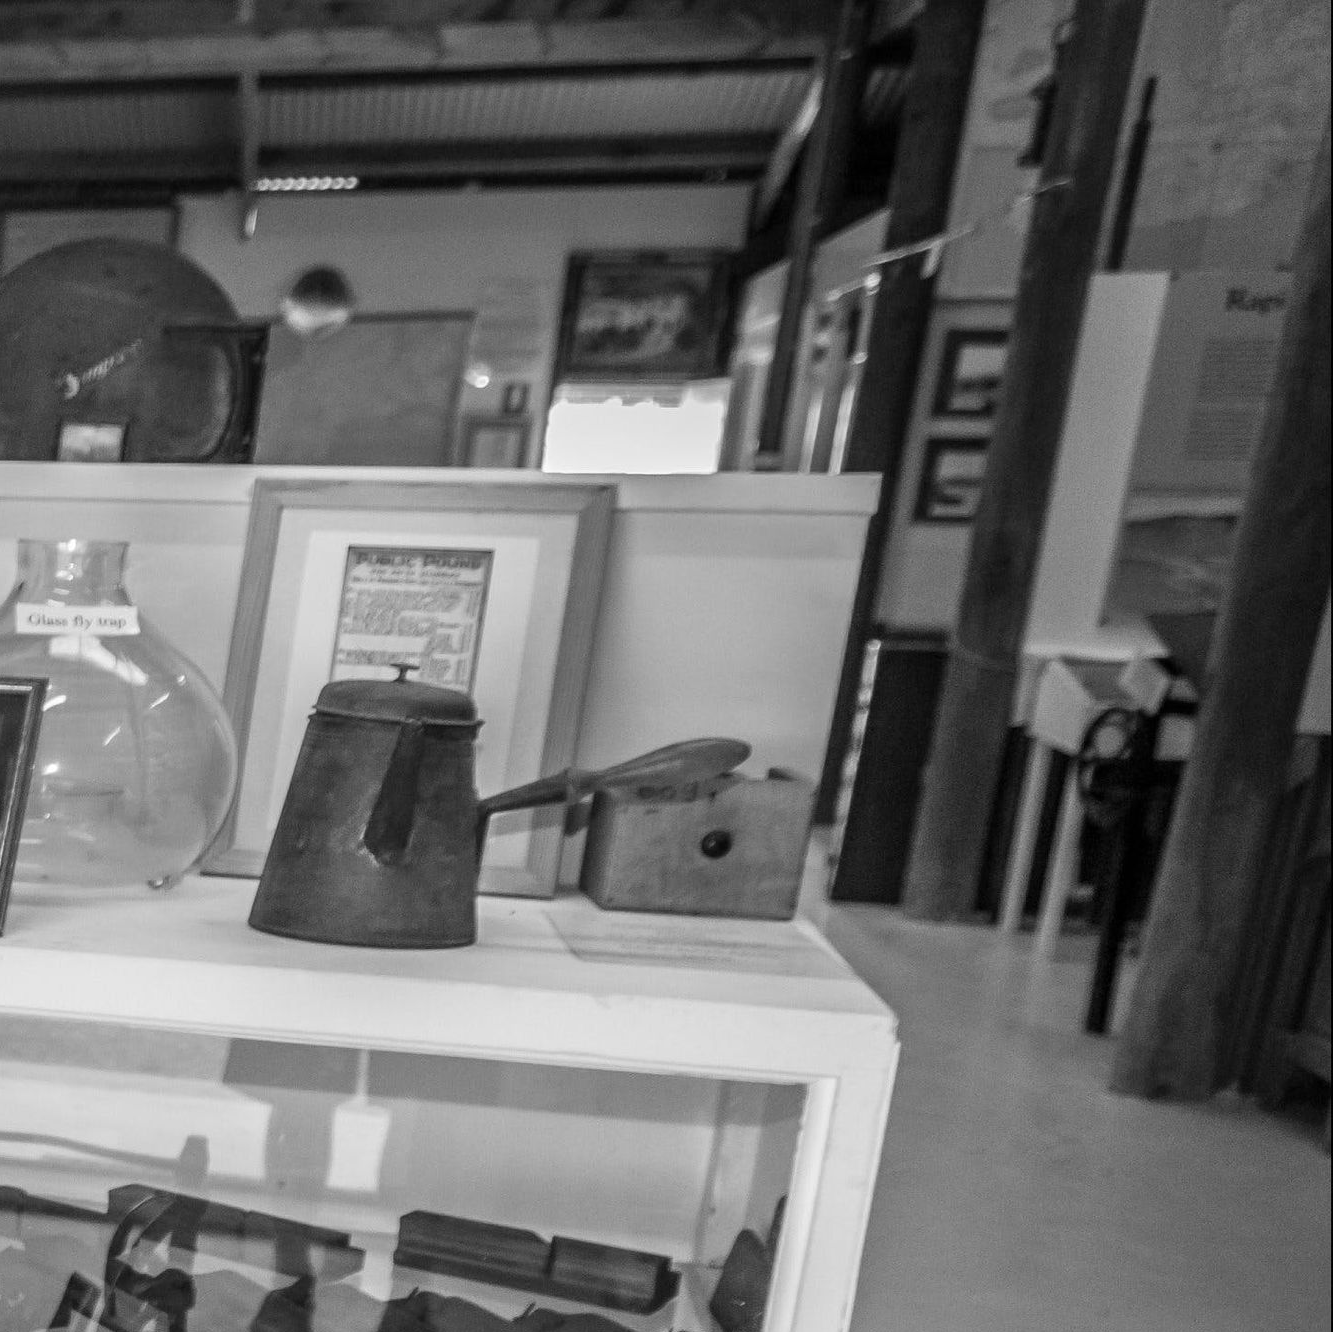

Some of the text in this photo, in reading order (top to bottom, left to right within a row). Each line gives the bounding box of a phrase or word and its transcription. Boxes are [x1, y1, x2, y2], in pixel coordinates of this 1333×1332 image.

[27, 611, 128, 630] Glass fly trap
